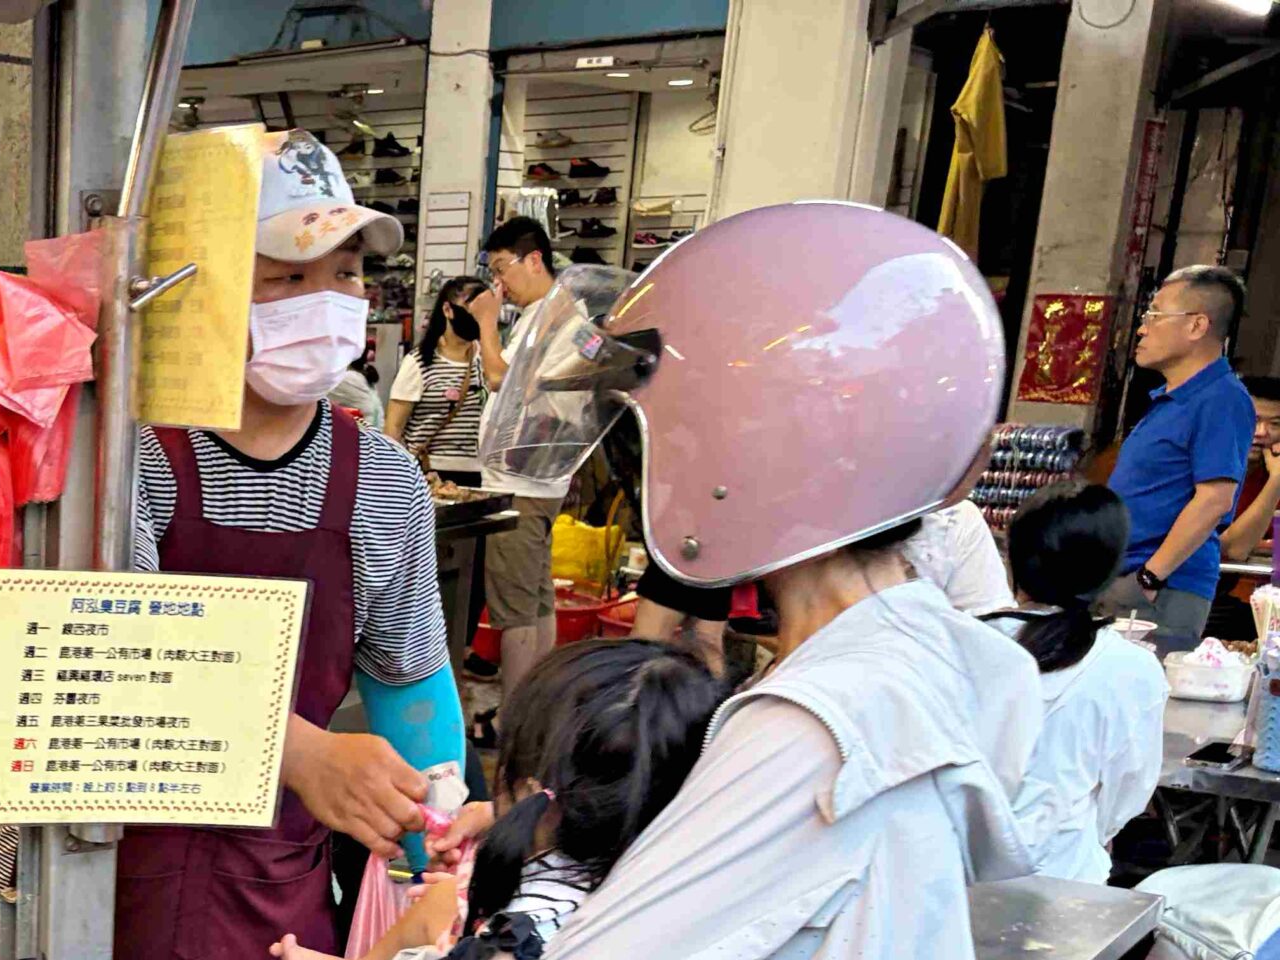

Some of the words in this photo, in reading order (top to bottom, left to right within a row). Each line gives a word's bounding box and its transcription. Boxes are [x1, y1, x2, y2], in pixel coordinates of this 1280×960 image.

[25, 622, 51, 635] 週一
[23, 645, 48, 658] 週二
[20, 669, 45, 682] 週三
[18, 692, 43, 705] 週四
[15, 715, 40, 728] 週五
[12, 737, 38, 750] 週六
[10, 760, 34, 772] 週日
